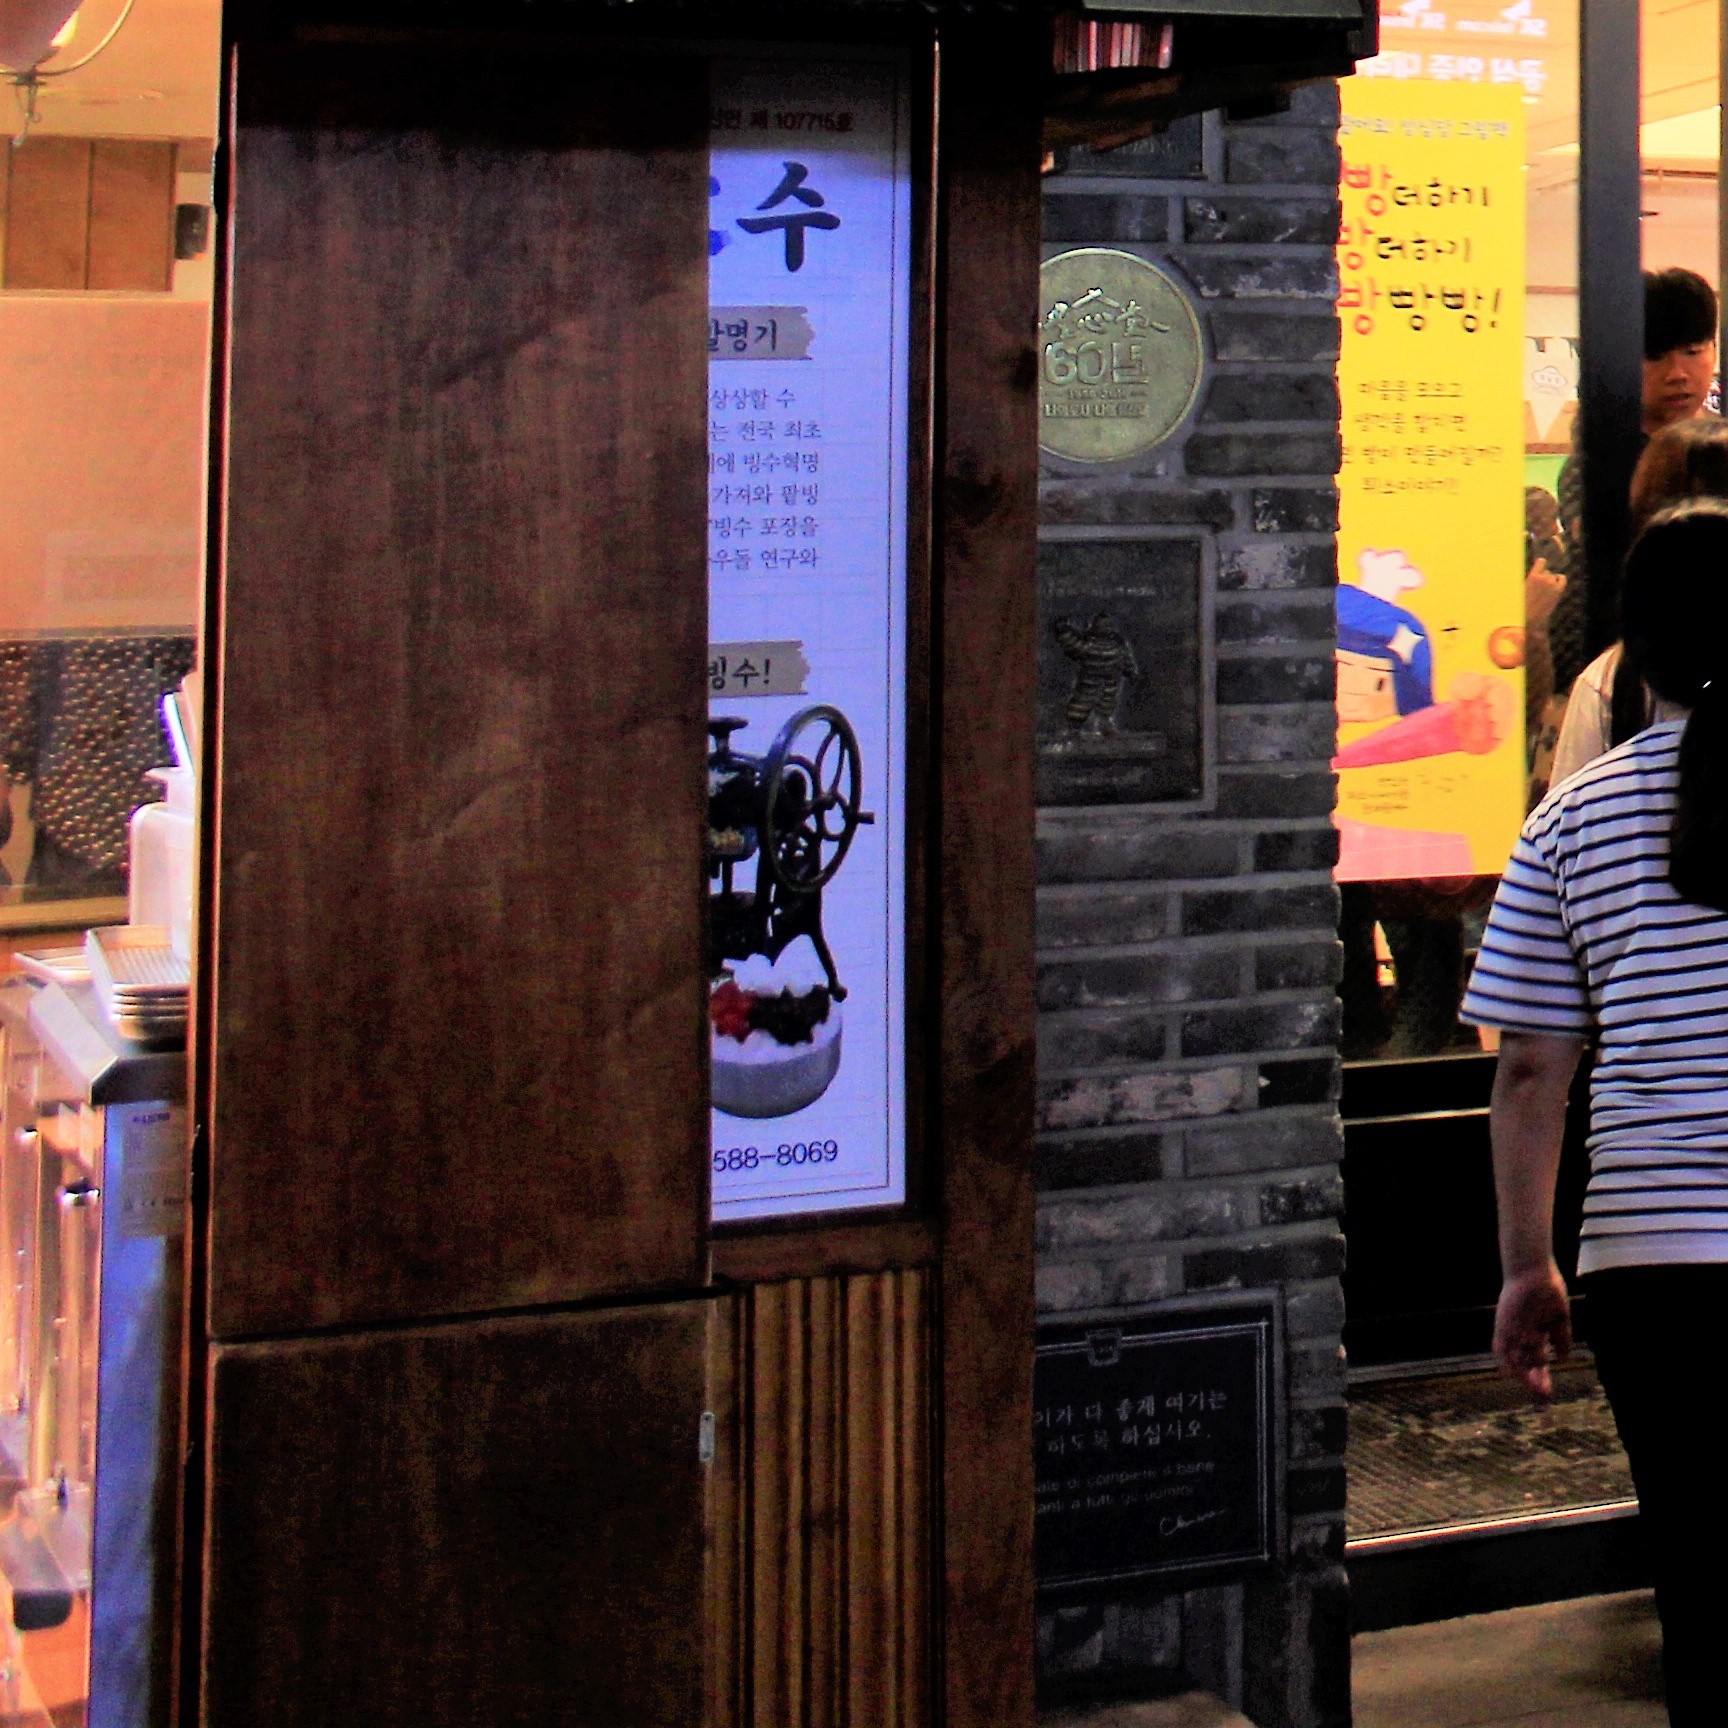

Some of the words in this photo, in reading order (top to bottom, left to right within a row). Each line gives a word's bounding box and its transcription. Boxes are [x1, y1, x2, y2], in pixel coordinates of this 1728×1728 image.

[709, 161, 841, 272] 수
[776, 388, 796, 409] 수
[742, 420, 775, 441] 전국
[710, 452, 735, 473] 에
[709, 516, 752, 539] 빙수
[761, 547, 821, 570] 연구와
[712, 1139, 838, 1172] 588-8069
